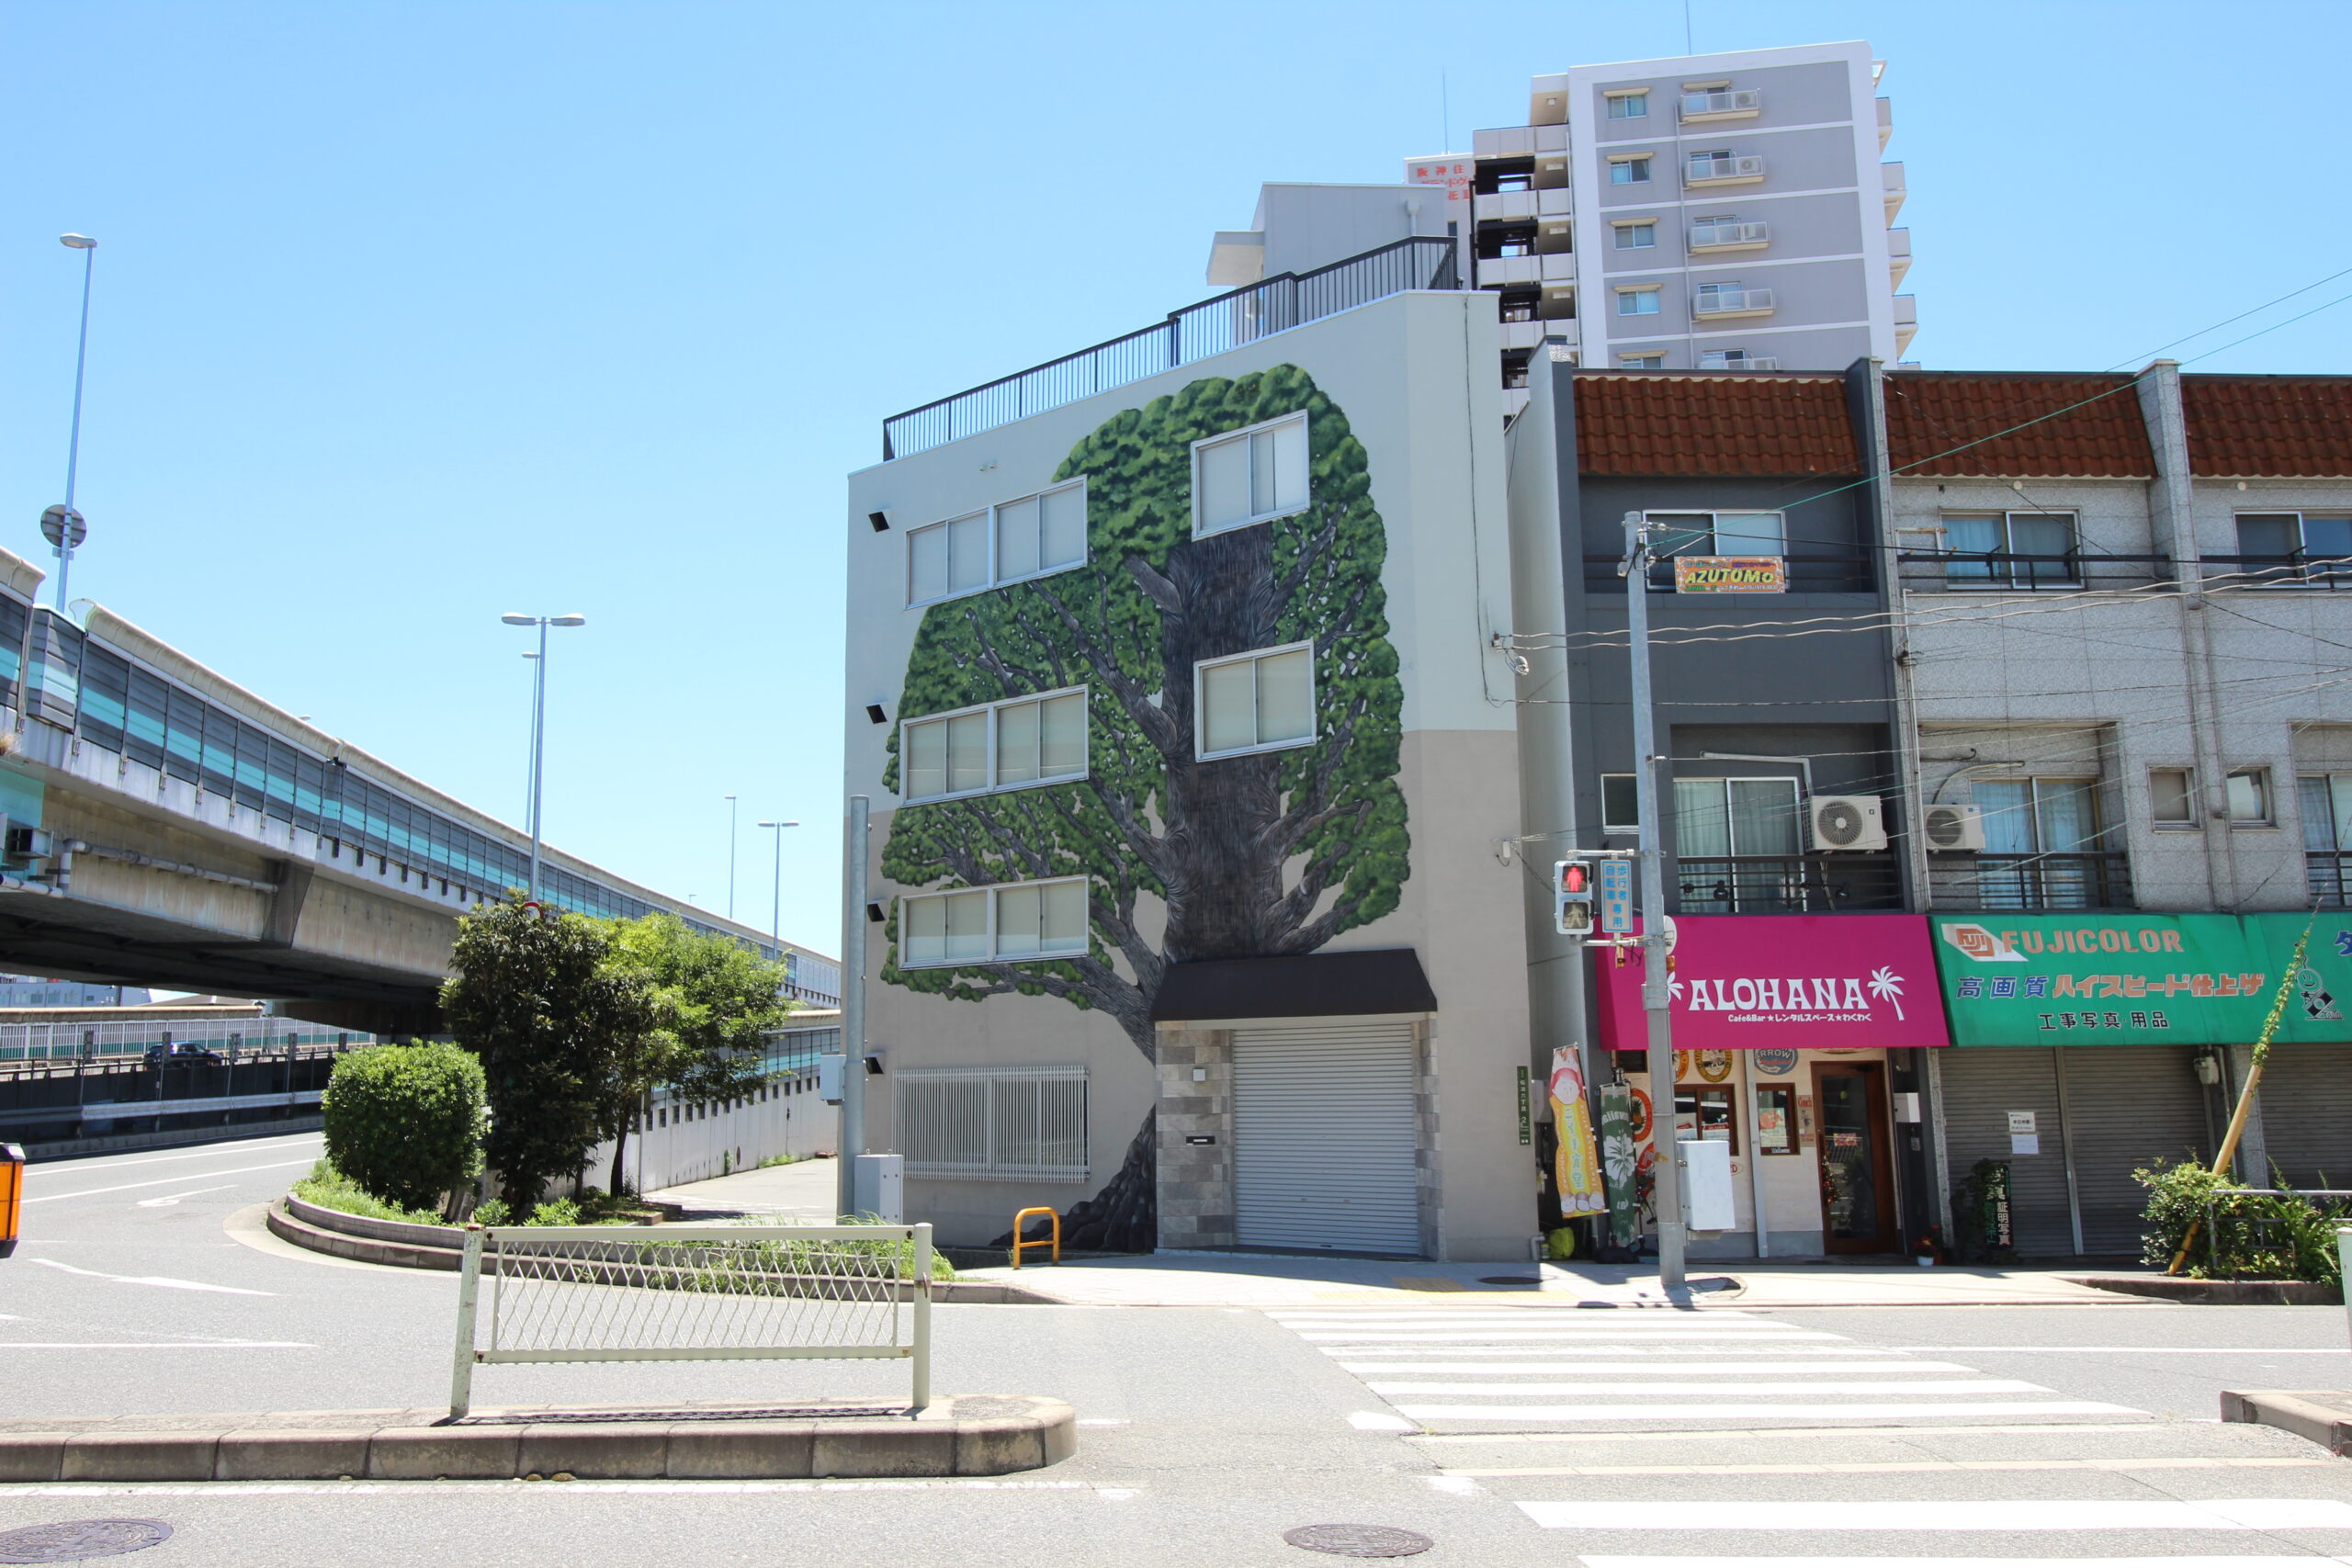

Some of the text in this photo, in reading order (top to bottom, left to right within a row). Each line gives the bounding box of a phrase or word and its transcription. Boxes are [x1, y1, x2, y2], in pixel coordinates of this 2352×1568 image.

[1684, 568, 1774, 584] AZUTOMO
[1605, 865, 1616, 900] 自転車
[1617, 865, 1627, 900] 歩行者
[1612, 903, 1623, 928] 専用
[2001, 929, 2184, 953] FUJICOLOR
[1689, 978, 1870, 1010] ALOHANA
[1728, 1013, 1765, 1022] Cafe&Bar
